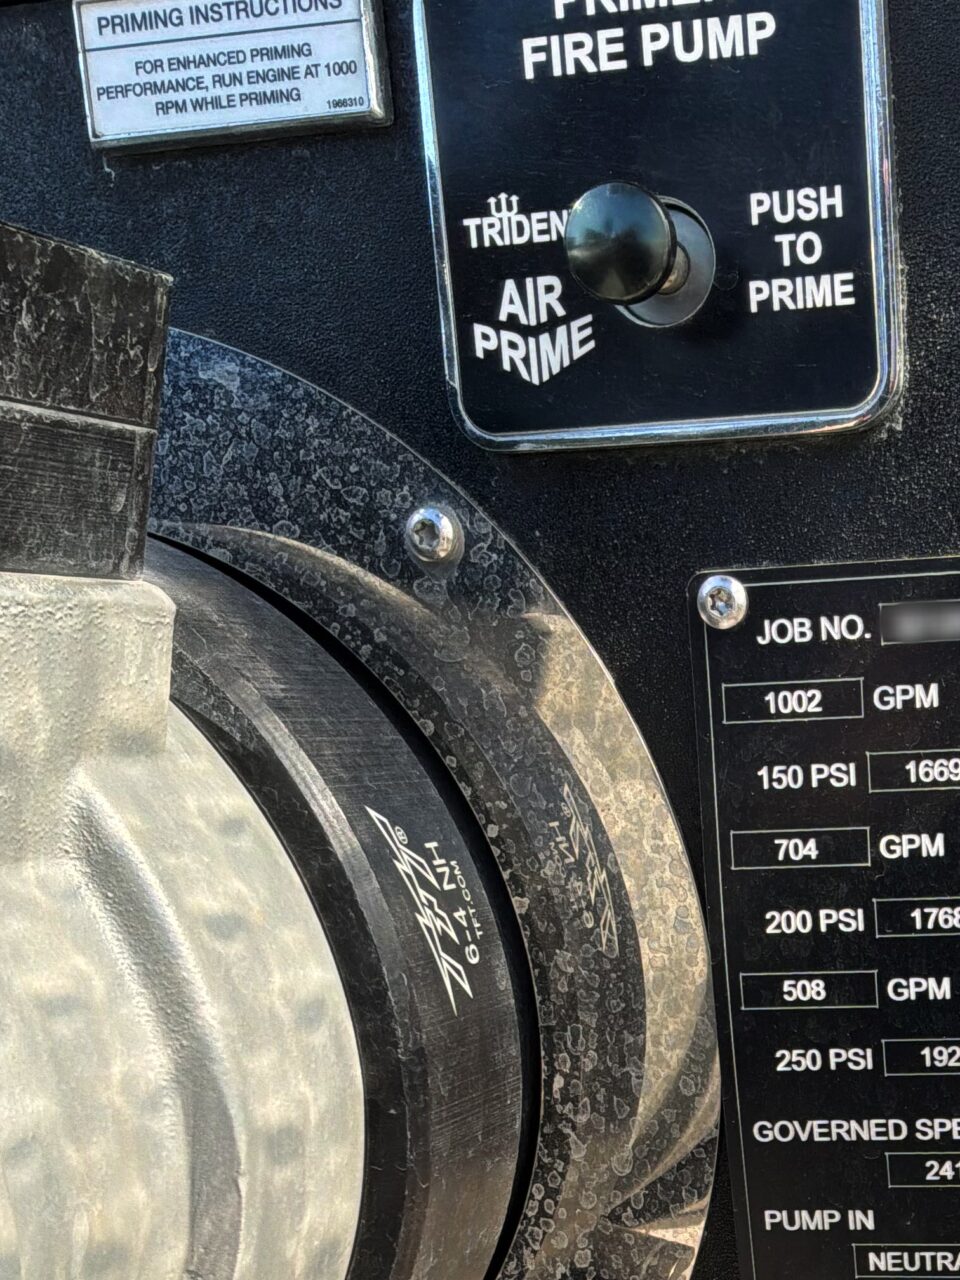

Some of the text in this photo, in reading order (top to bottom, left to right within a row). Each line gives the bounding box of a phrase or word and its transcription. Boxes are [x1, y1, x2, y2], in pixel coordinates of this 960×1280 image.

[97, 7, 183, 36] PRIMING
[134, 42, 312, 76] FOR ENHANCED PRIMING
[522, 11, 776, 79] FIRE PUMP
[96, 60, 358, 102] PERFORMANCE, RUN ENGINE AT 1000
[155, 87, 302, 117] RPM WHILE PRIMING
[750, 185, 843, 225] PUSH
[463, 210, 571, 248] TRIDEN
[775, 231, 822, 266] TO
[499, 275, 566, 327] AIR
[749, 272, 855, 313] PRIME
[473, 315, 595, 385] PRIME
[757, 618, 812, 644] JOB
[820, 615, 871, 641] NO.
[765, 683, 938, 713] 1002 GPM
[758, 765, 803, 789] 150
[811, 763, 856, 787] PSI
[775, 833, 944, 860] 704 GPM
[424, 841, 457, 891] NH
[449, 860, 484, 941] TFT.COM
[766, 910, 812, 933] 200
[819, 909, 864, 932] PSI
[783, 977, 950, 1001] 508 GPM
[776, 1049, 821, 1071] 250
[829, 1048, 872, 1070] PSI
[753, 1119, 907, 1142] GOVERNED
[765, 1210, 874, 1230] PUMP IN
